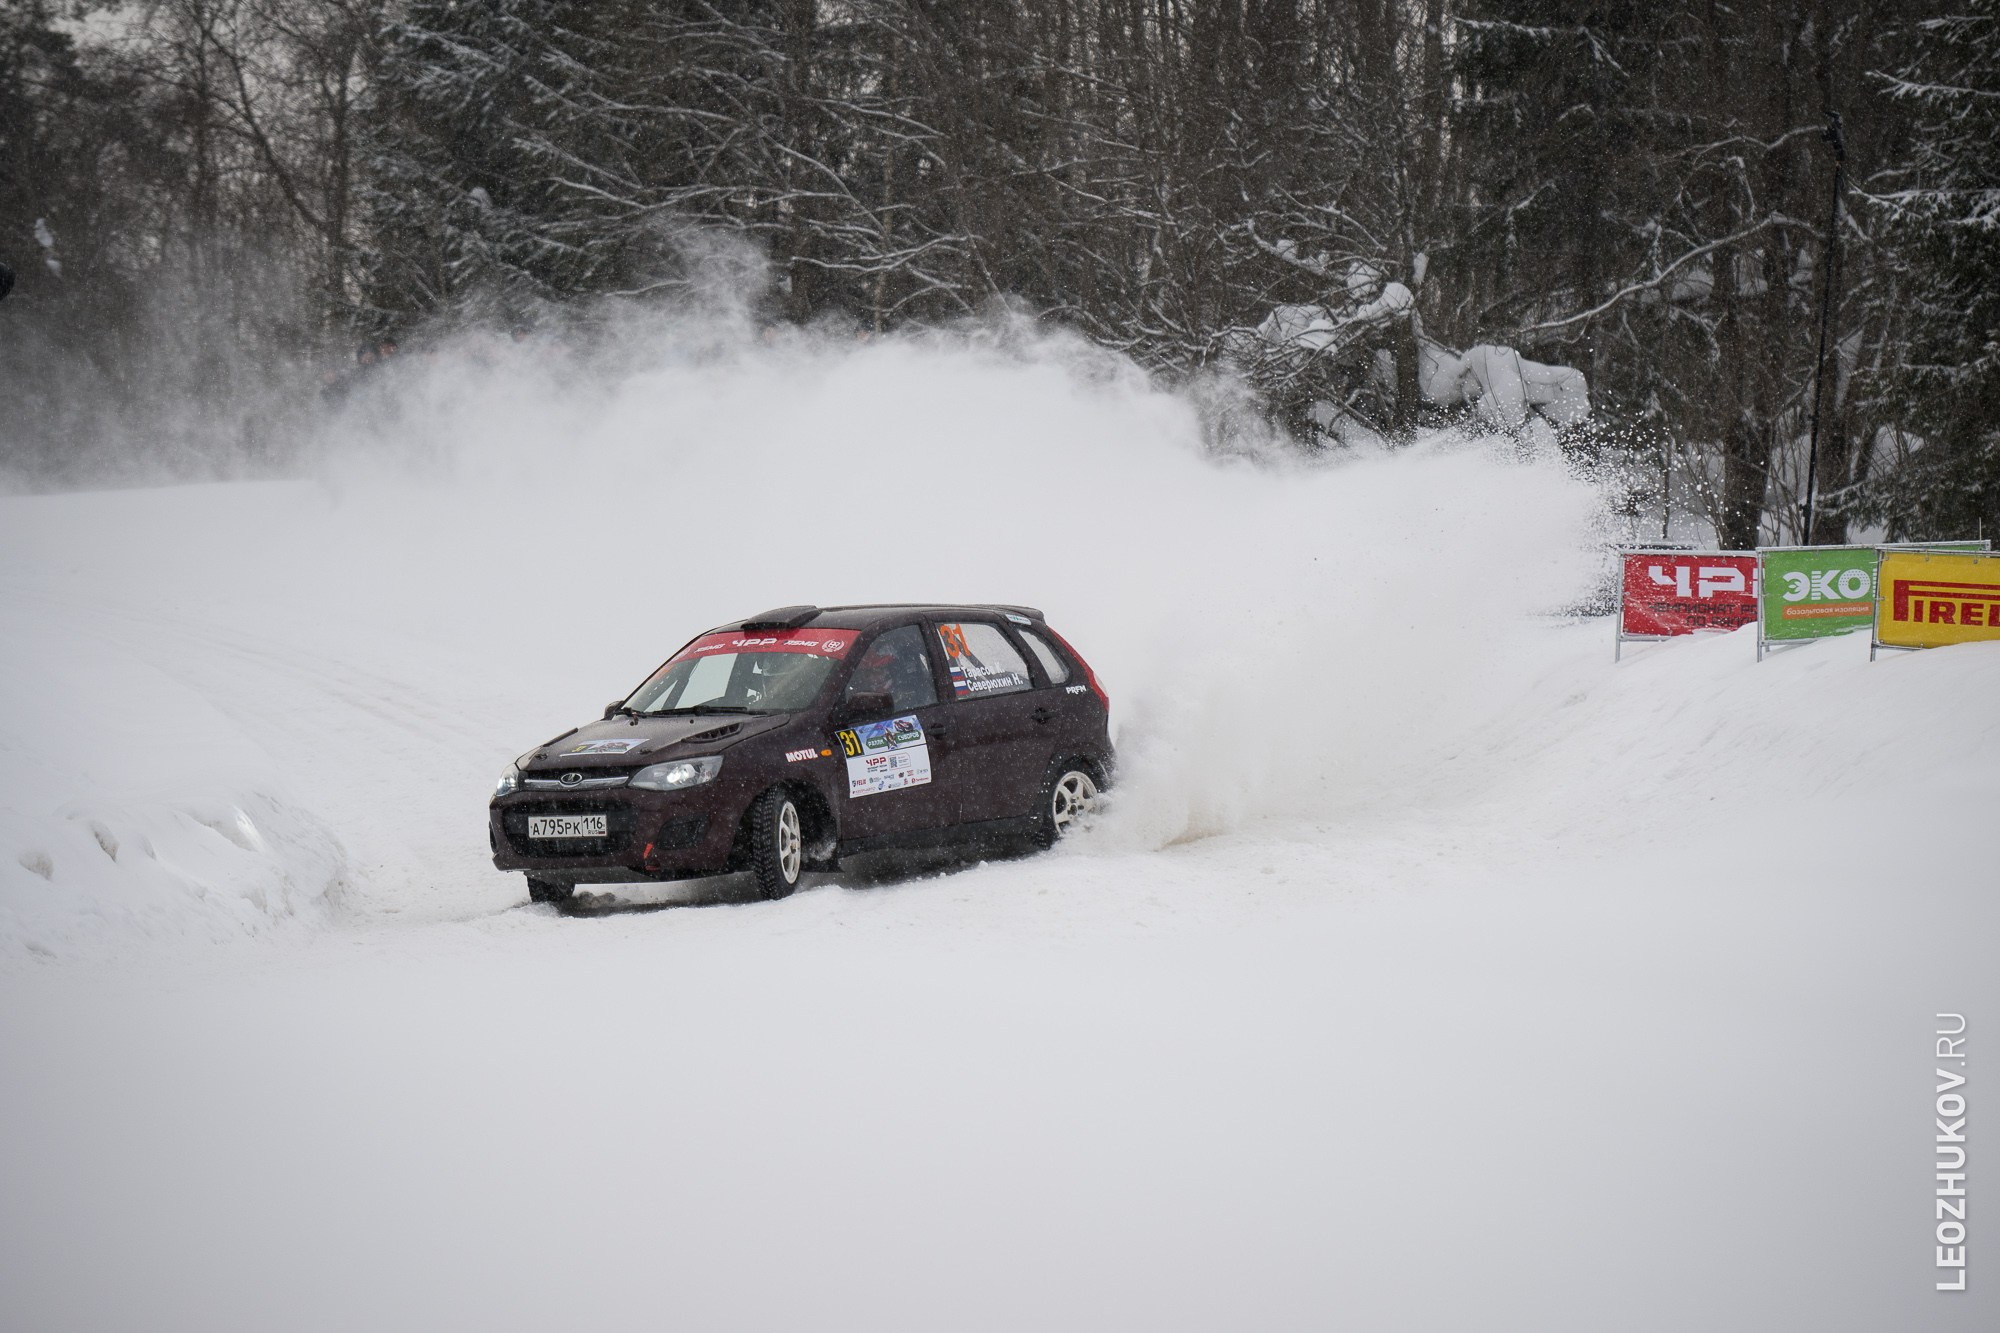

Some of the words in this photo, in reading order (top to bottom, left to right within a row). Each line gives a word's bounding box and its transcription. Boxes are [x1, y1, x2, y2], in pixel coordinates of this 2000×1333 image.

[1648, 602, 1736, 614] ЧЕМПИОНАТ
[1786, 607, 1834, 616] базальтовая
[940, 624, 971, 658] 31
[967, 676, 1012, 692] Северюхин
[1011, 673, 1023, 685] Н.
[840, 730, 861, 756] 31
[785, 748, 818, 763] MOTUL
[532, 819, 581, 836] А795РК
[583, 817, 603, 830] 116
